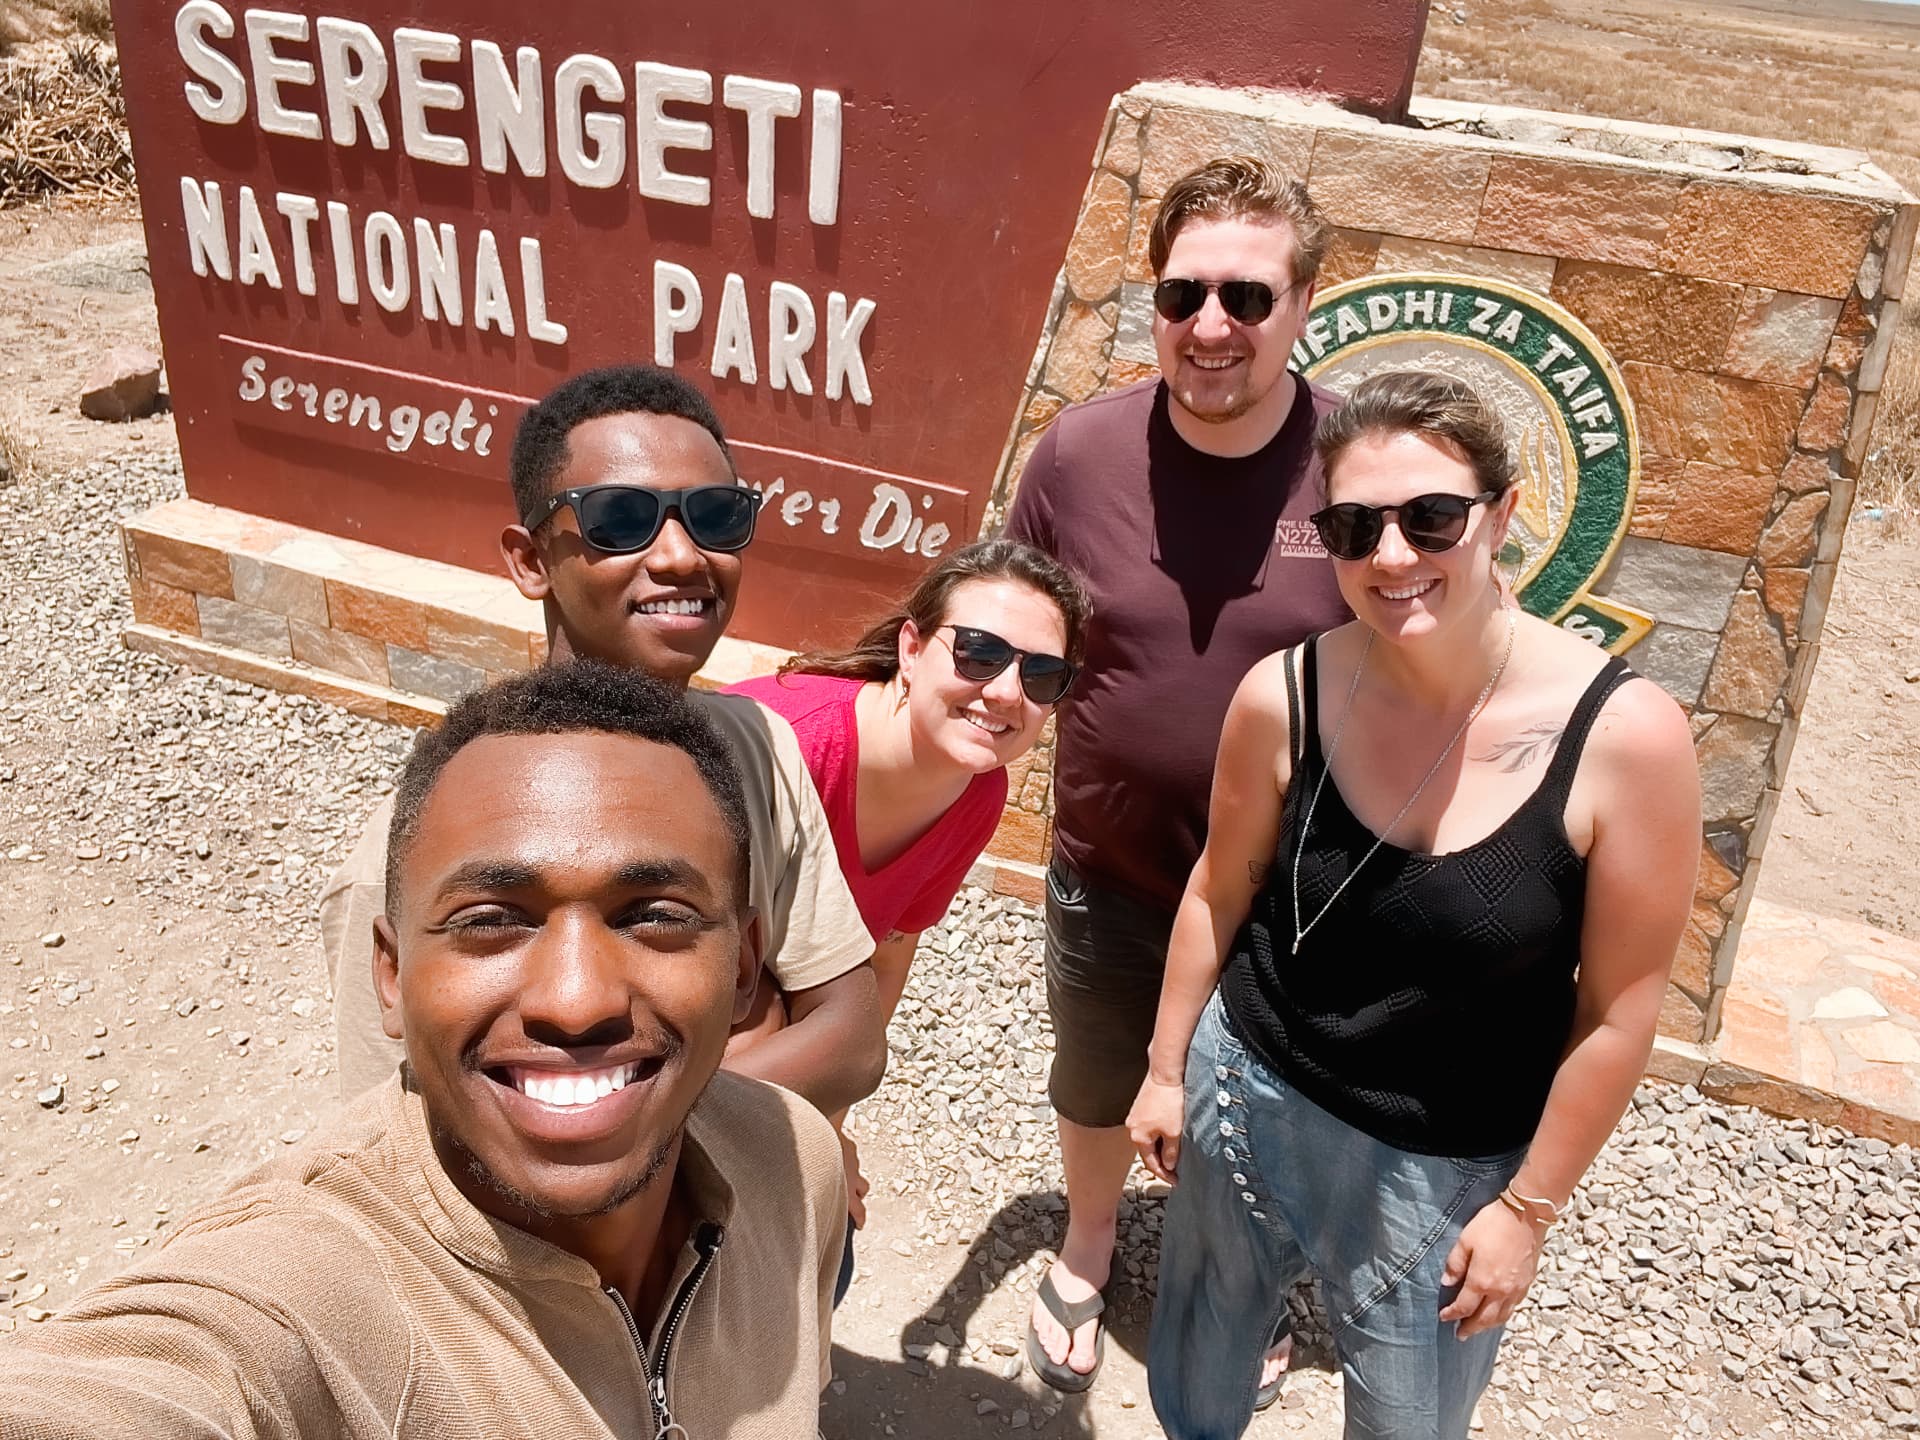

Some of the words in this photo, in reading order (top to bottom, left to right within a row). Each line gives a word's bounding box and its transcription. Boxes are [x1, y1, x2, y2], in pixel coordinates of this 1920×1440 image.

[175, 0, 843, 226] SERENGETI
[180, 175, 568, 345] NATIONAL
[653, 259, 877, 406] PARK
[1467, 296, 1523, 345] ZA
[1535, 333, 1618, 460] TAIFA
[238, 355, 498, 456] Serengeti
[859, 483, 950, 558] Die
[1277, 520, 1297, 529] PME
[1283, 544, 1327, 554] AVIATOR
